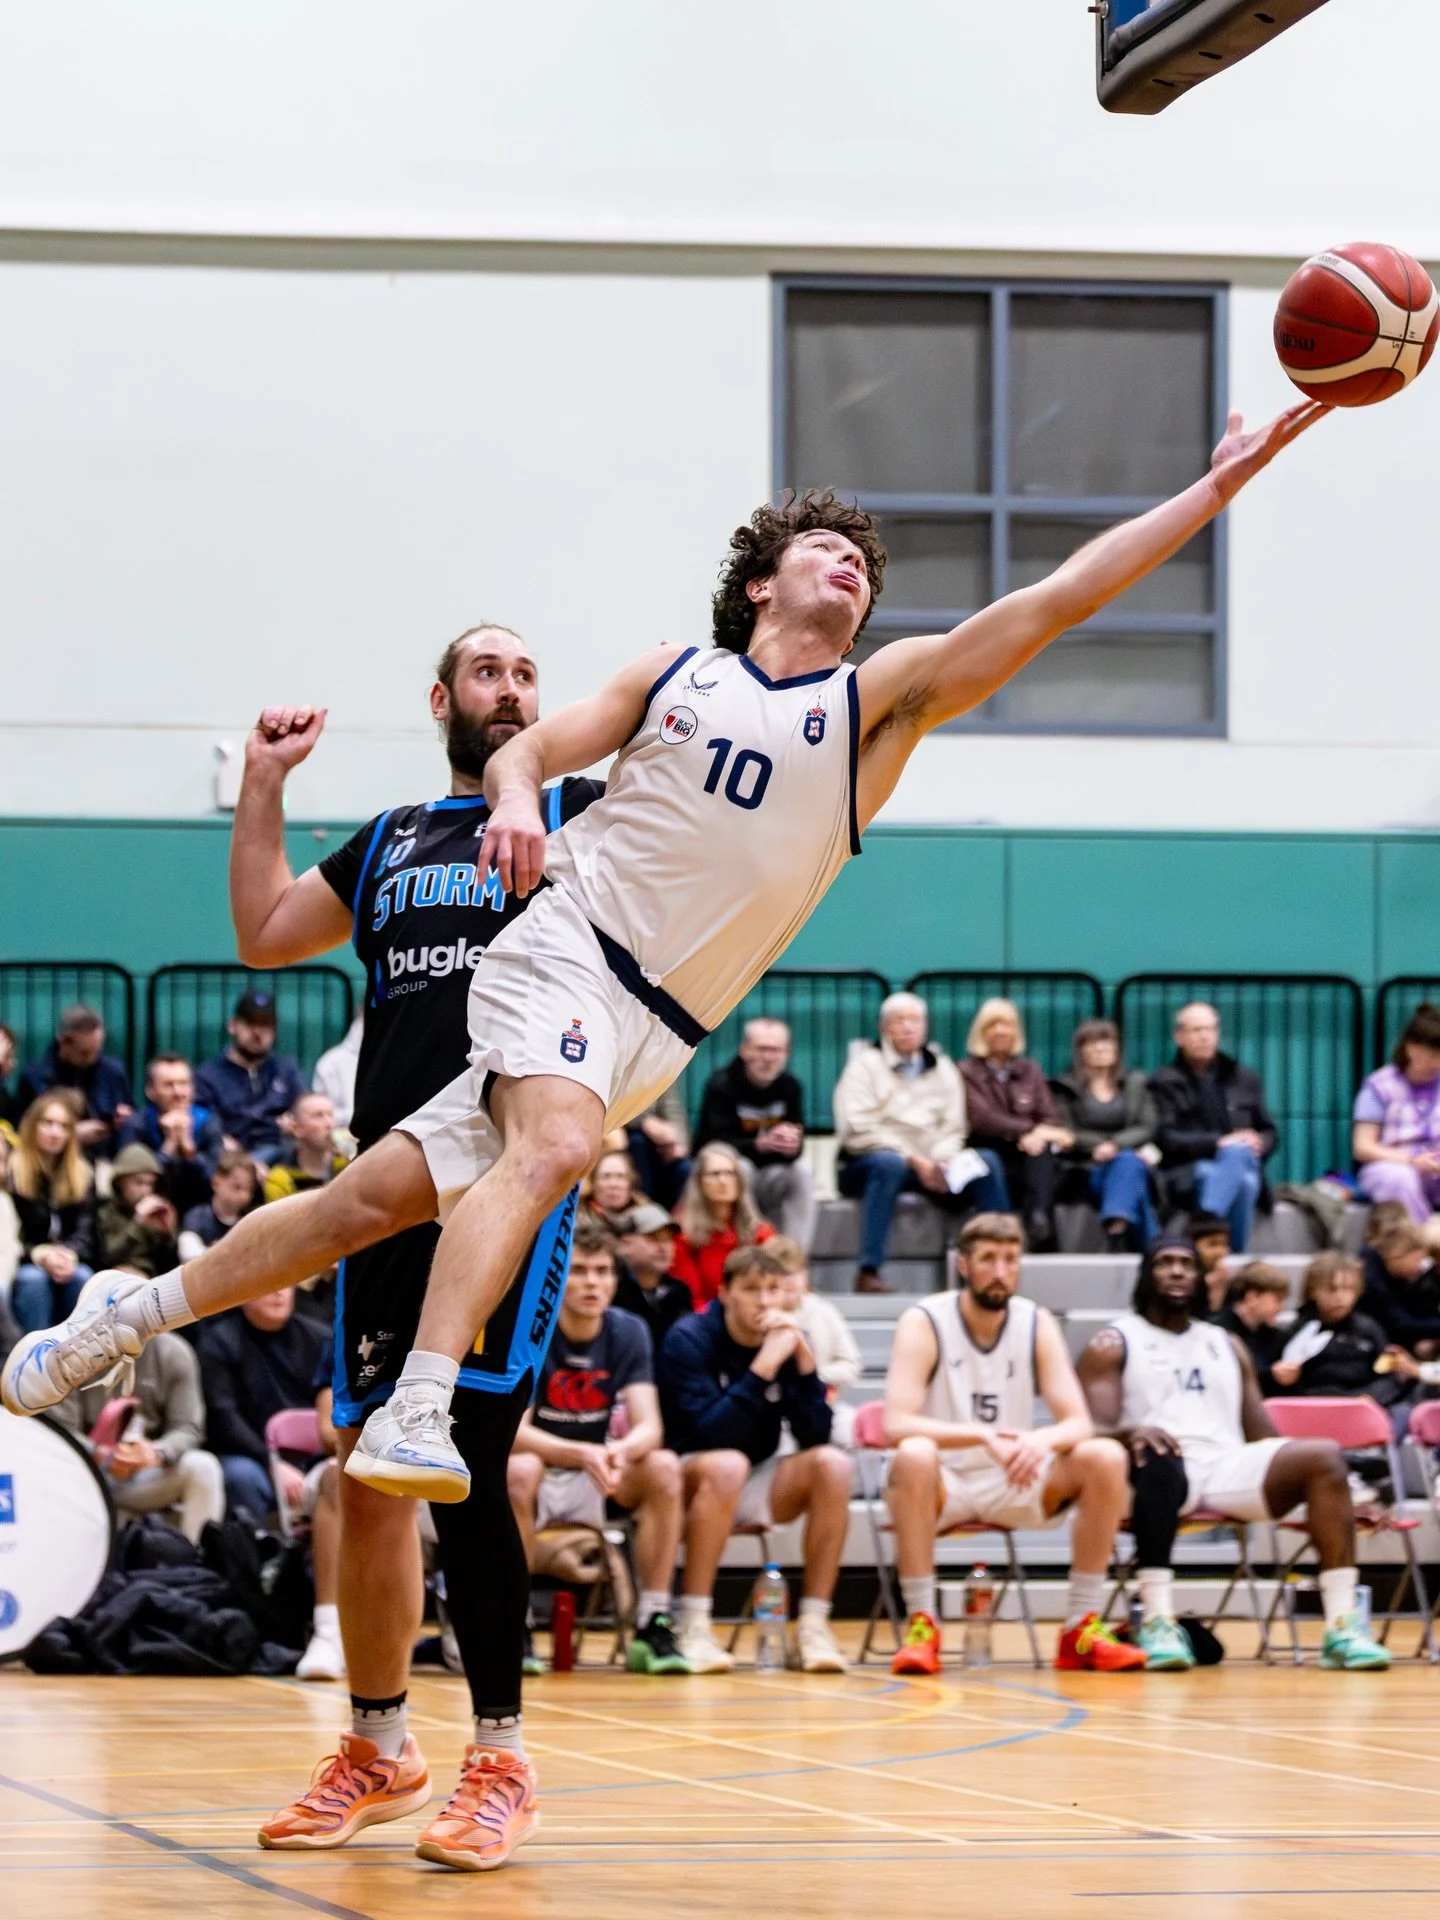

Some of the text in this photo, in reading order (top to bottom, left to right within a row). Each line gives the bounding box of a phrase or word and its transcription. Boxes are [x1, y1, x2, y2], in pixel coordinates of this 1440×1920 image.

[673, 723, 691, 736] BIG
[703, 737, 773, 810] 10
[372, 863, 506, 932] STORM
[387, 980, 428, 999] GROUP
[972, 1393, 999, 1424] 15
